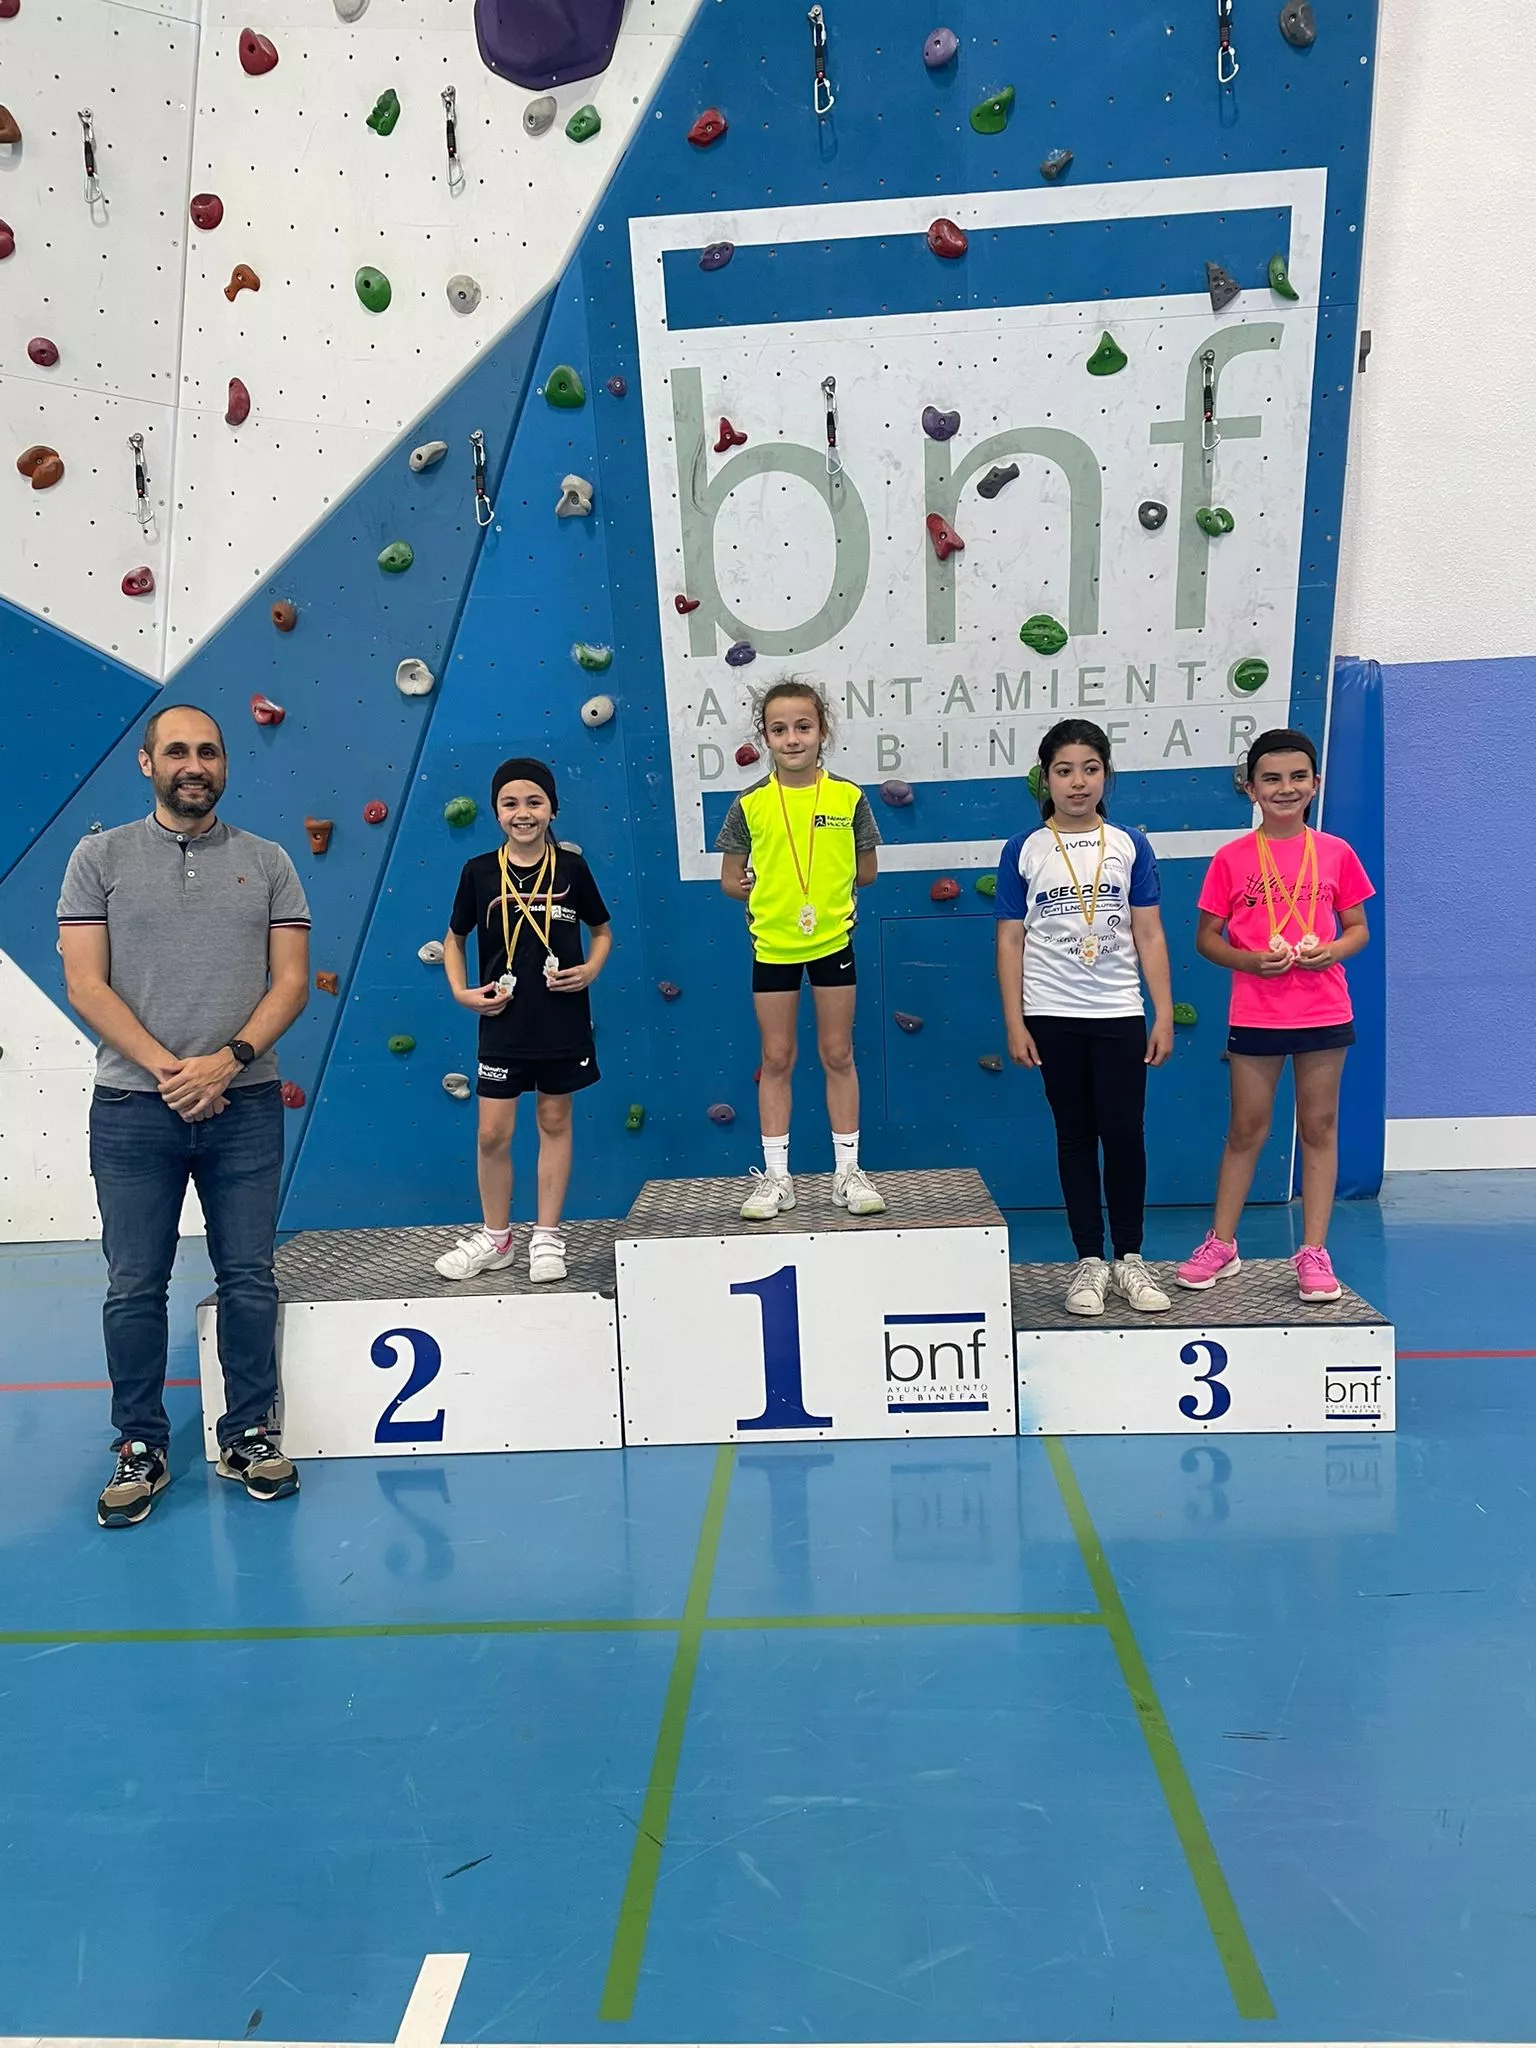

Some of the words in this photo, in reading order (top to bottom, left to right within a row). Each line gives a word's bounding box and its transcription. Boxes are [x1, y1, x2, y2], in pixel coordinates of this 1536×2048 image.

[670, 322, 1285, 658] bnf
[696, 656, 1265, 727] ANTAMIENTO
[876, 714, 1258, 772] BINFAR
[1049, 884, 1110, 898] GECRO
[729, 1265, 832, 1430] 1
[884, 1328, 987, 1382] bnf
[370, 1327, 446, 1444] 2
[886, 1394, 904, 1402] DE
[887, 1384, 988, 1394] AYUNTAMIENTO
[1178, 1340, 1231, 1421] 3
[1325, 1375, 1381, 1403] bnf
